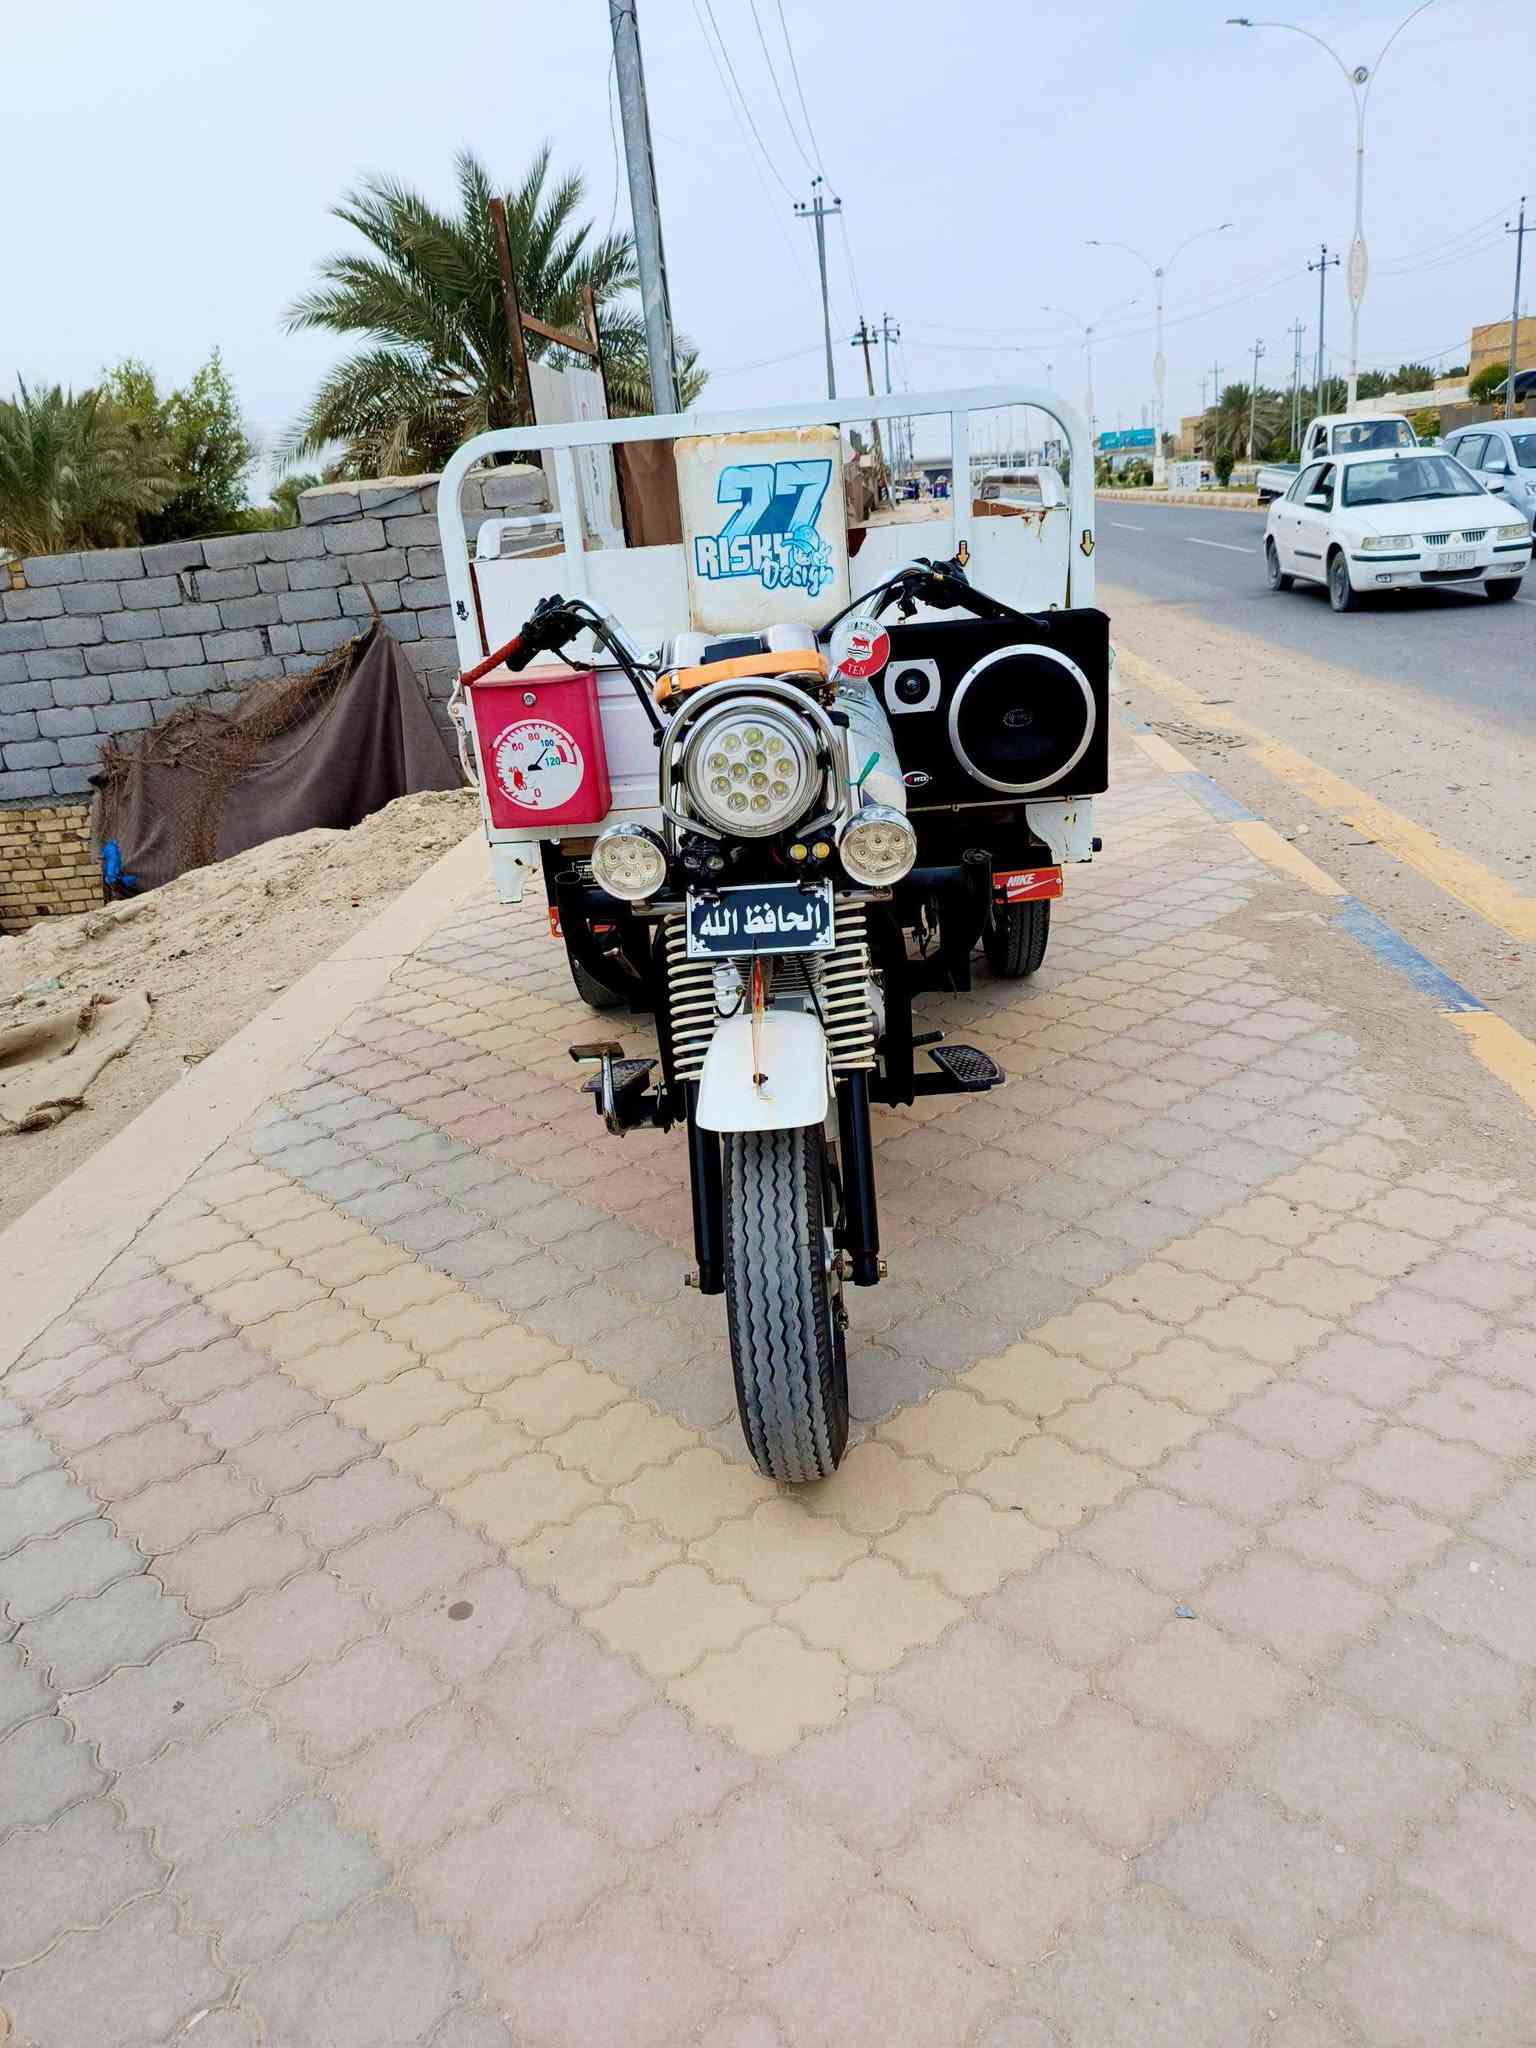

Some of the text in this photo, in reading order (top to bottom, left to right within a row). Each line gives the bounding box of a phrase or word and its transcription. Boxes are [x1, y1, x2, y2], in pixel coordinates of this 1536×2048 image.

[695, 532, 793, 579] RISKY
[760, 558, 834, 597] Design
[847, 663, 866, 676] TEN
[528, 732, 540, 741] 80
[511, 743, 524, 751] 60
[545, 757, 561, 766] 120
[534, 788, 541, 797] 0
[1007, 873, 1036, 888] NIKE
[699, 899, 822, 936] الحافظ الله
